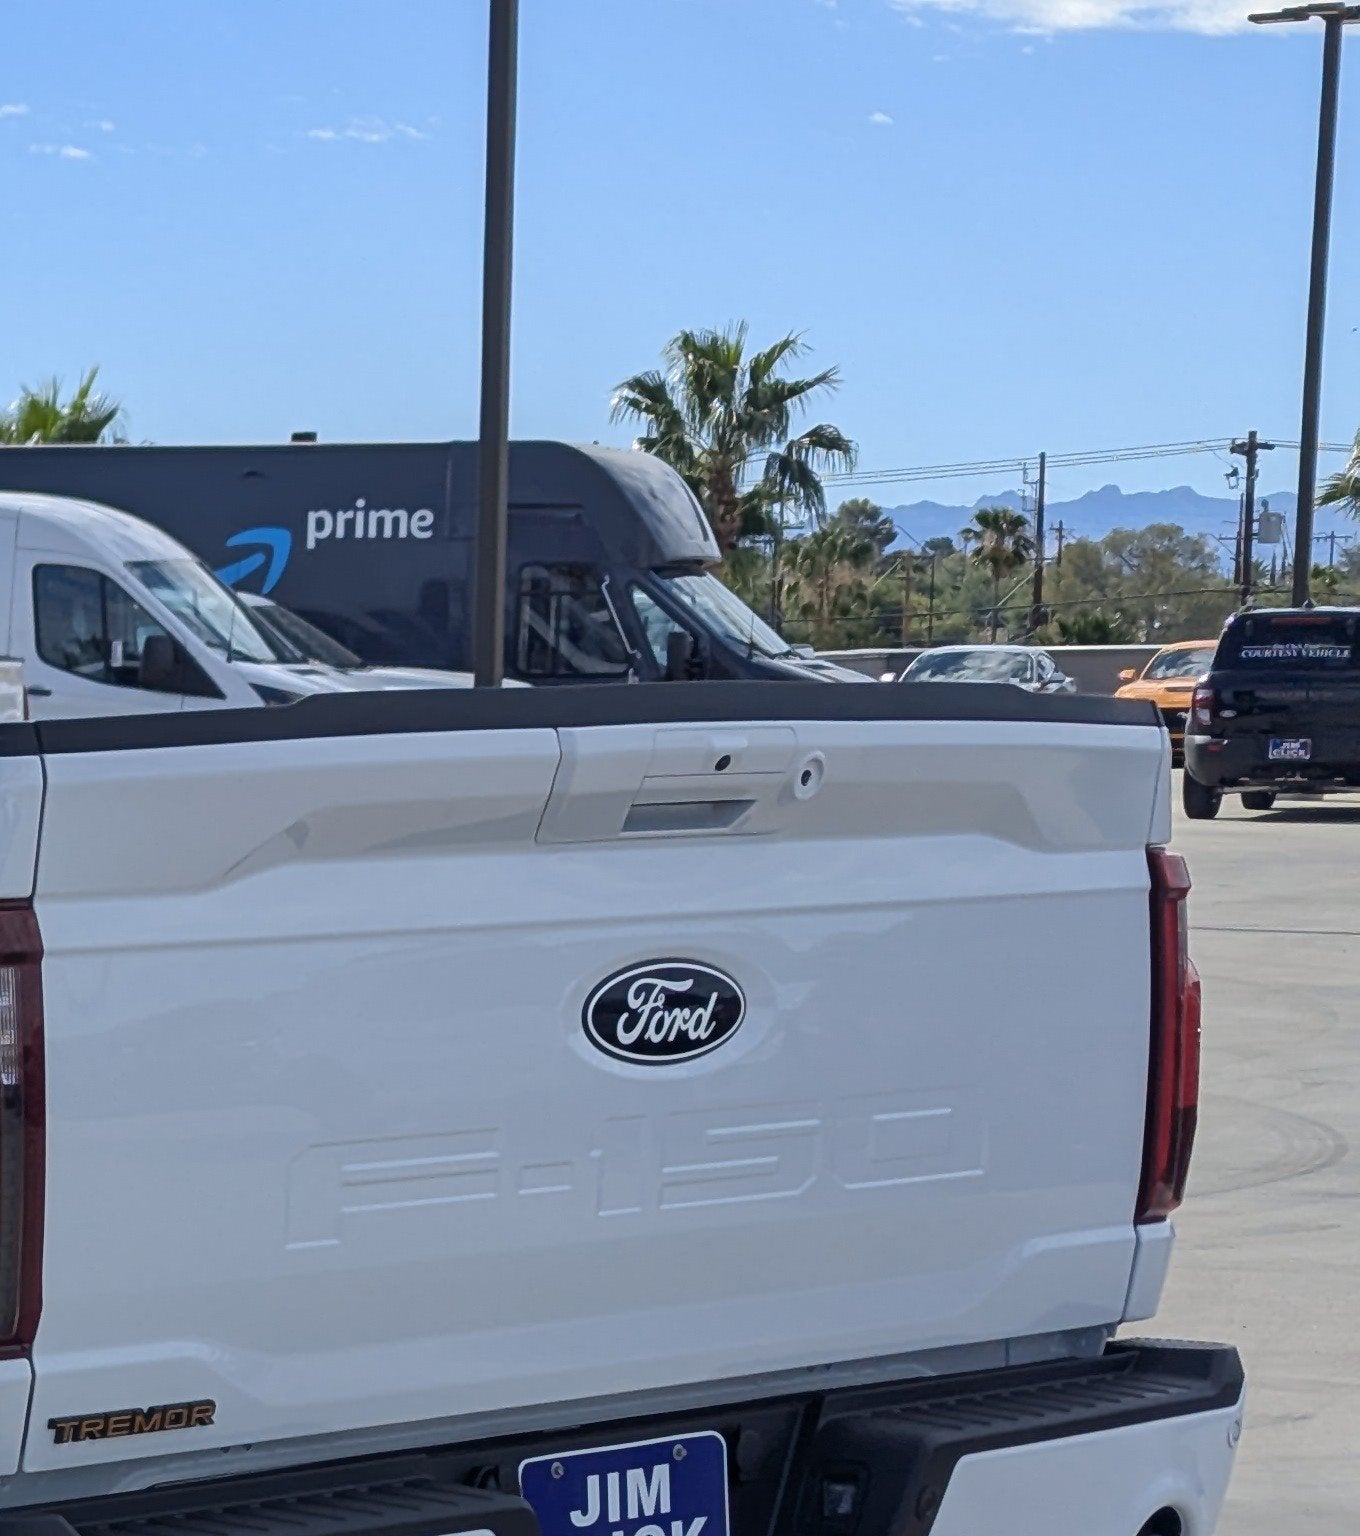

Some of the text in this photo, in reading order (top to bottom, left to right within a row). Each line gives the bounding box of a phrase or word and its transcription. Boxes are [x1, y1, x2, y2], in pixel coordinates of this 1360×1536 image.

[306, 498, 434, 550] prime
[616, 977, 718, 1045] Ford
[284, 1085, 987, 1250] F-150
[48, 1399, 217, 1444] TREMOR
[569, 1463, 671, 1527] JIM
